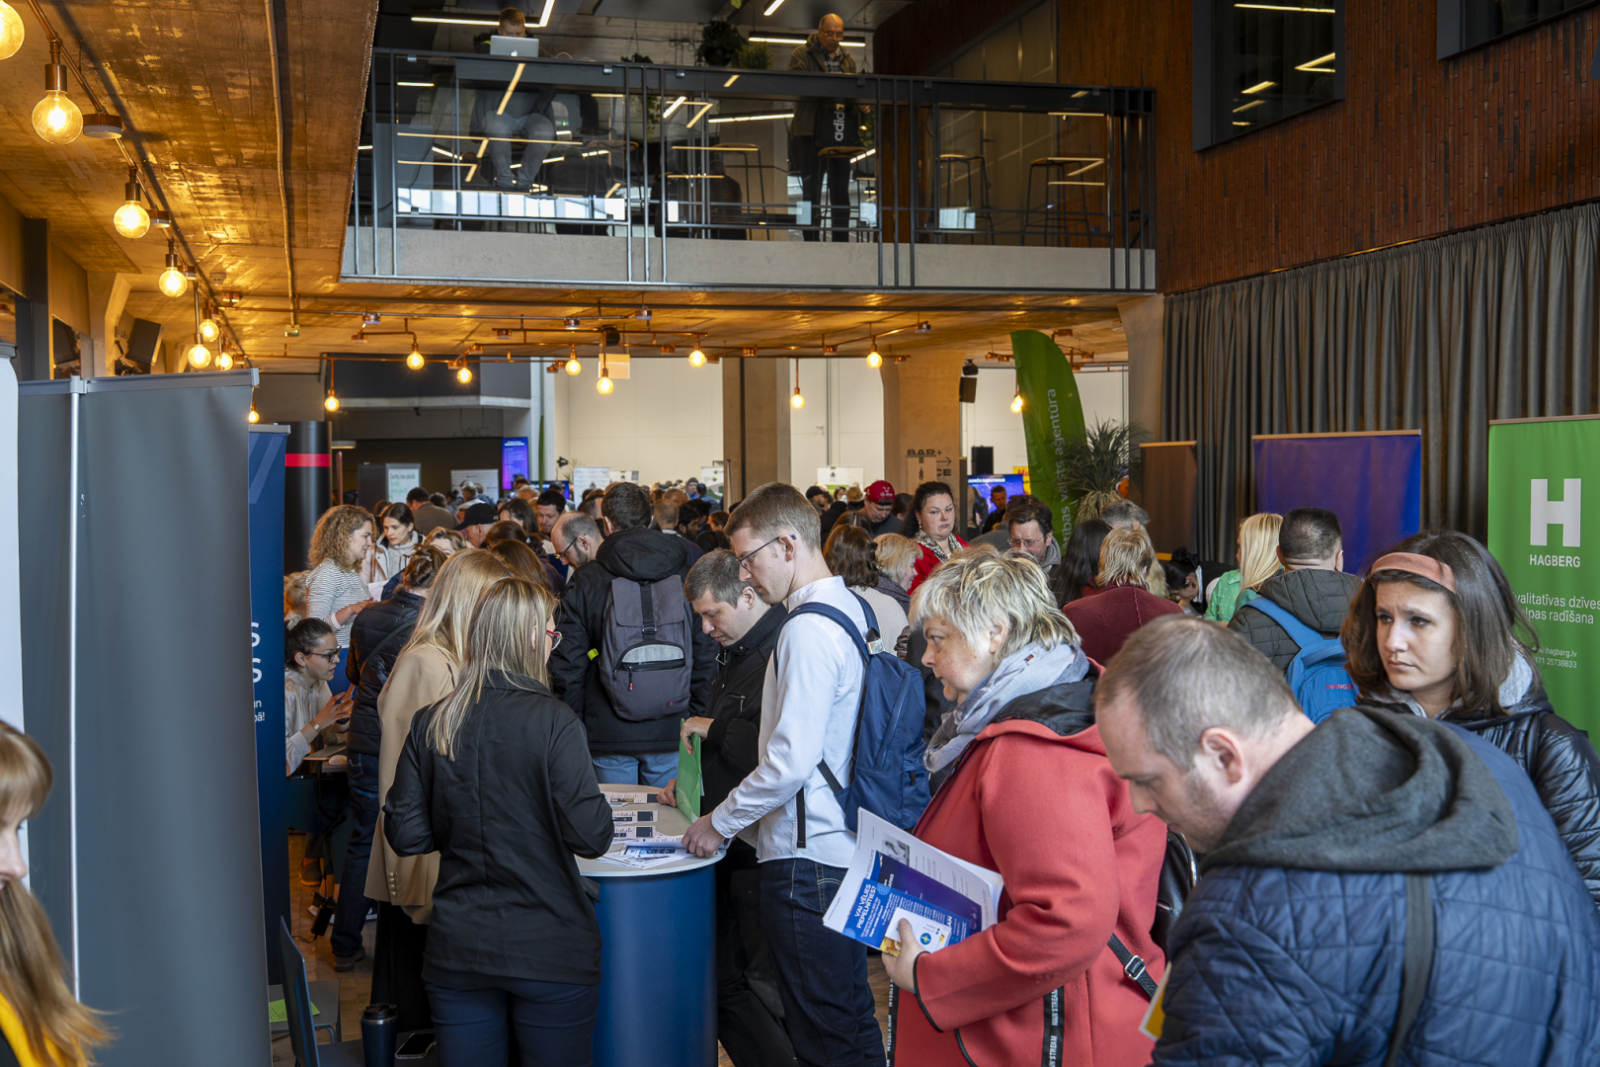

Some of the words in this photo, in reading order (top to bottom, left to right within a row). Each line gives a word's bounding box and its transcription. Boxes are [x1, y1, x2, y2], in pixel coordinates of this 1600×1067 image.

[1530, 478, 1581, 547] H
[1530, 554, 1581, 568] HAGBERG
[1513, 592, 1566, 607] valitatīvas
[1568, 595, 1600, 610] dzīves
[1549, 609, 1594, 625] radīšana
[854, 904, 863, 917] VAI
[1049, 1035, 1058, 1060] STREAM
